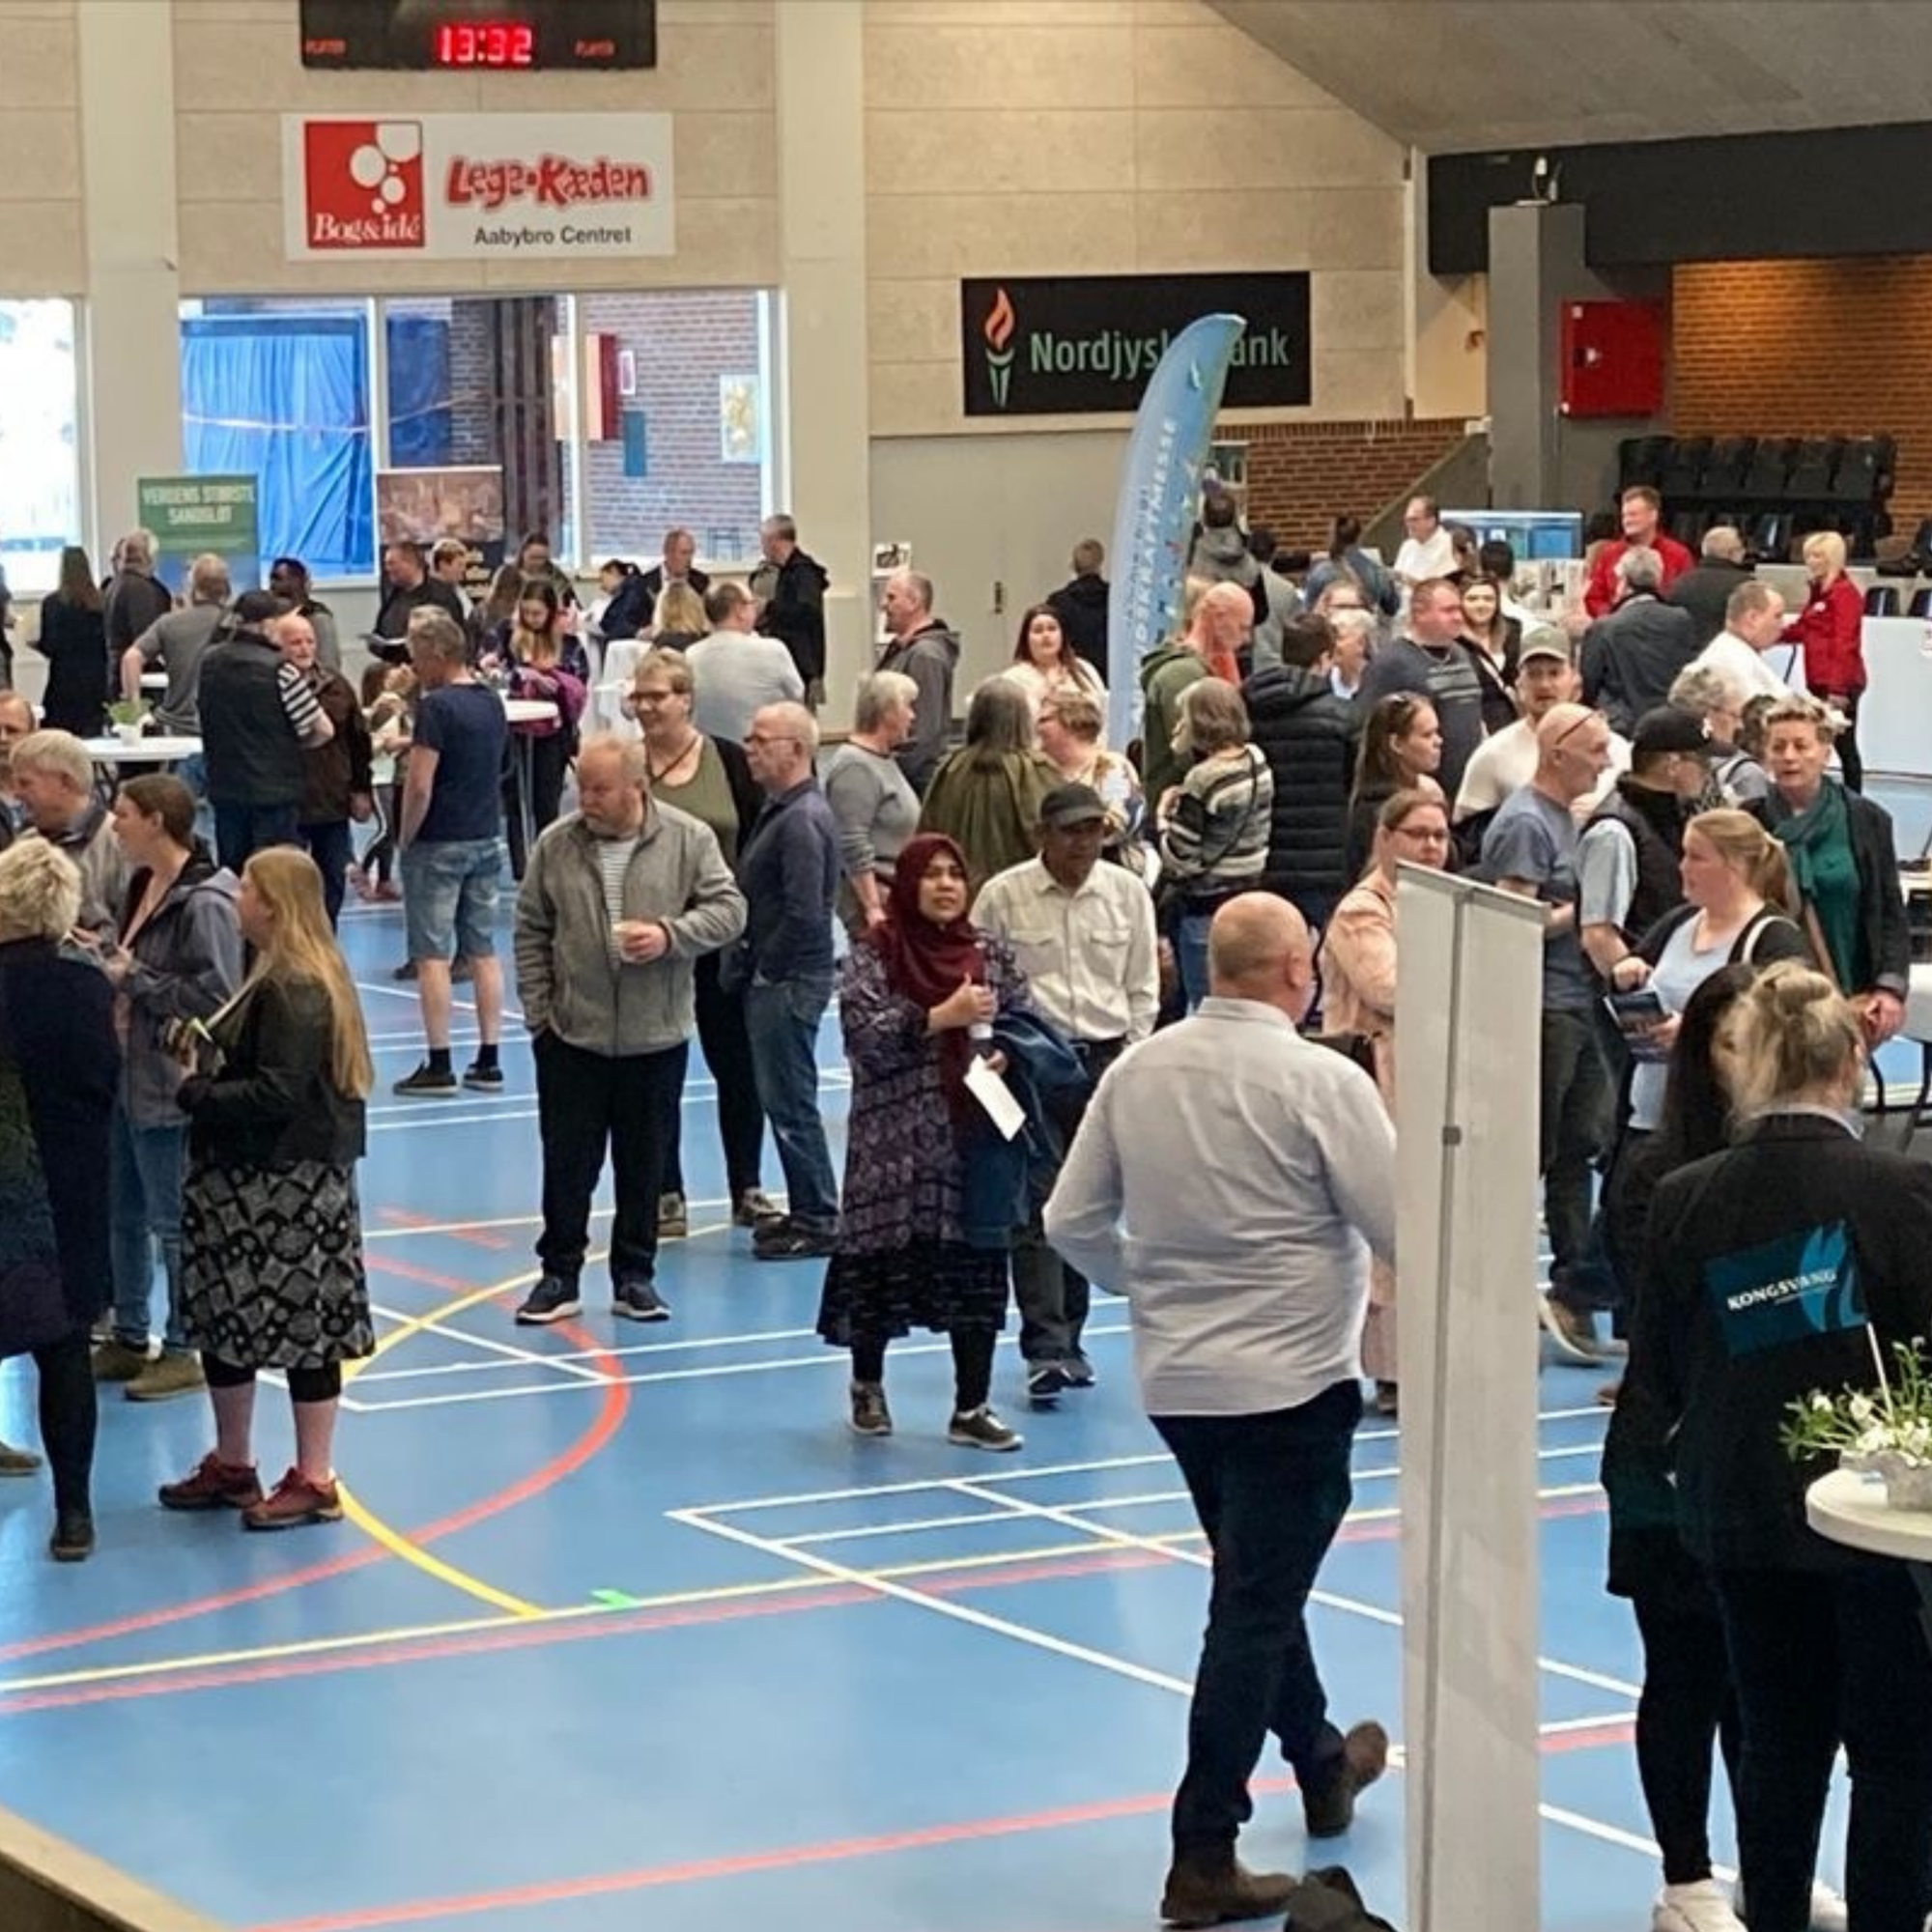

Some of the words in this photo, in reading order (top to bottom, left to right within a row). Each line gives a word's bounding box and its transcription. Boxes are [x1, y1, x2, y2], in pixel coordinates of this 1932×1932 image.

[440, 26, 533, 63] 13:32
[314, 213, 421, 243] Bog&idé
[474, 226, 555, 246] Aabybro
[1030, 327, 1169, 380] Nordjys
[1229, 327, 1291, 366] ank
[1727, 1267, 1838, 1311] KONGSVANG
